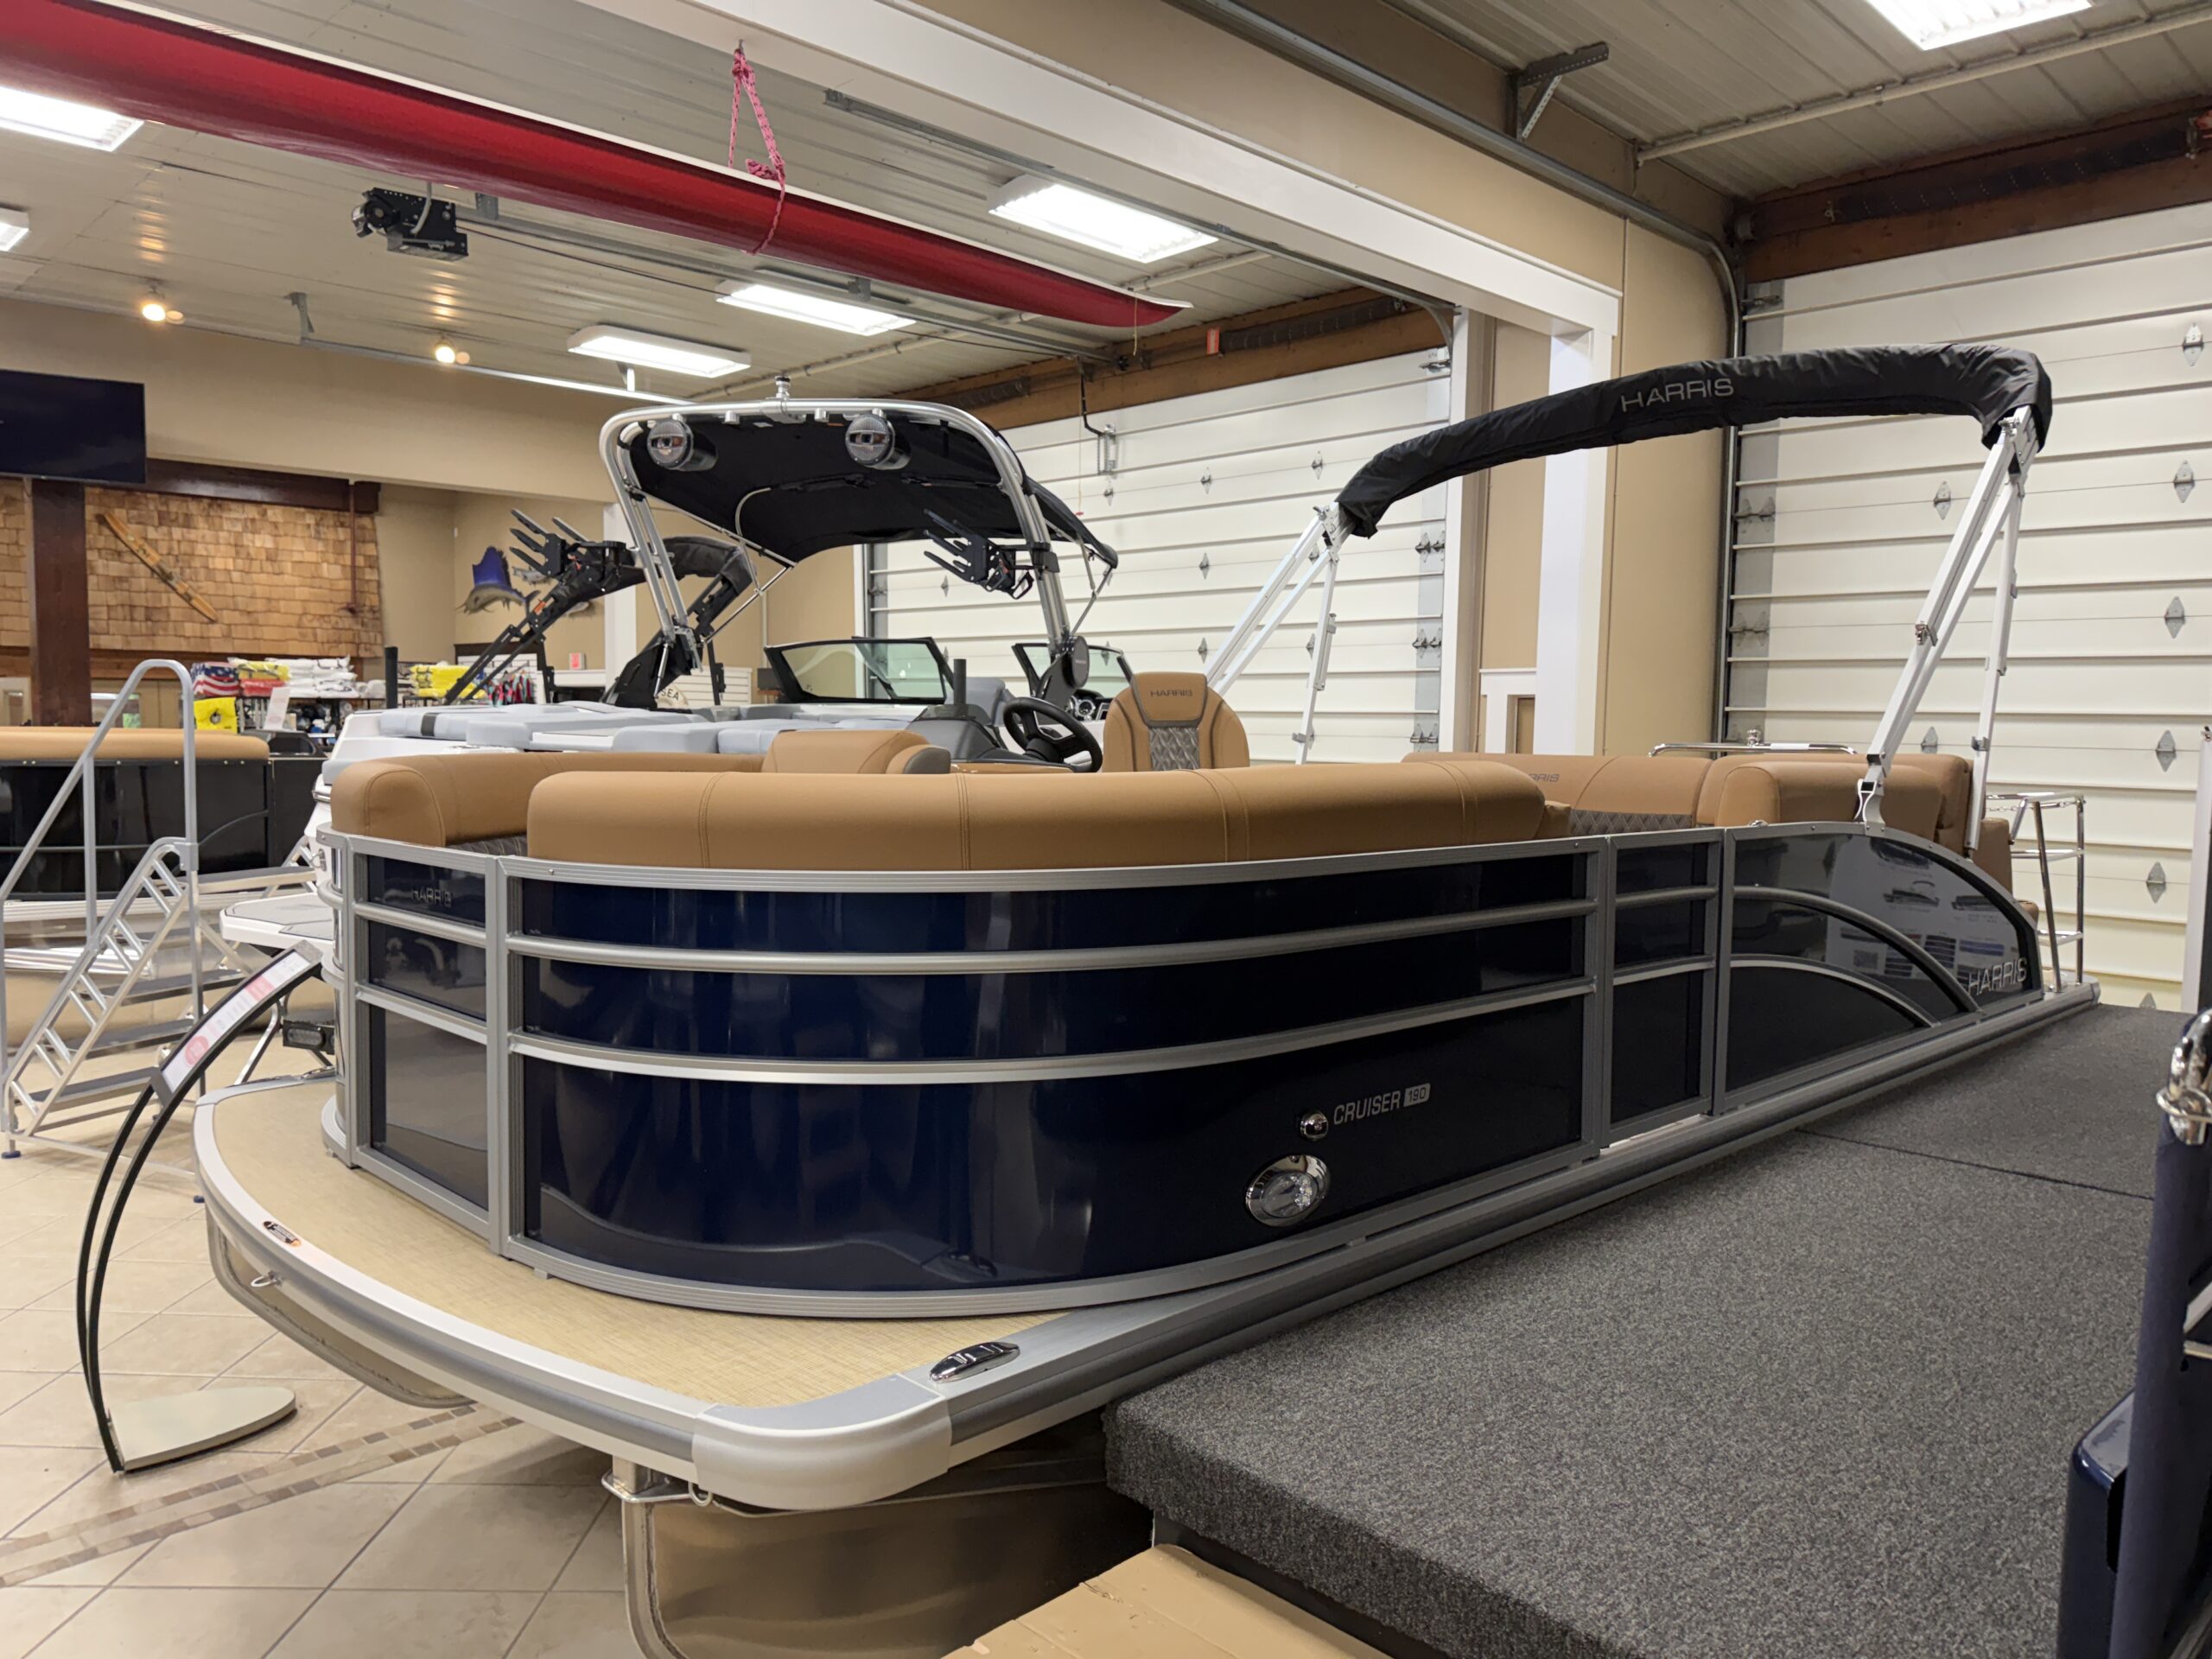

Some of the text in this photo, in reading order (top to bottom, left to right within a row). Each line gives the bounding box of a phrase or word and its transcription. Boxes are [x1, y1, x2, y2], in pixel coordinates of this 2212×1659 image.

[1621, 378, 1734, 412] HARRIS
[1529, 773, 1560, 782] RRIS
[410, 887, 452, 908] HARRIS
[1968, 957, 2027, 995] HARRIS
[1333, 1090, 1401, 1125] CRUISER
